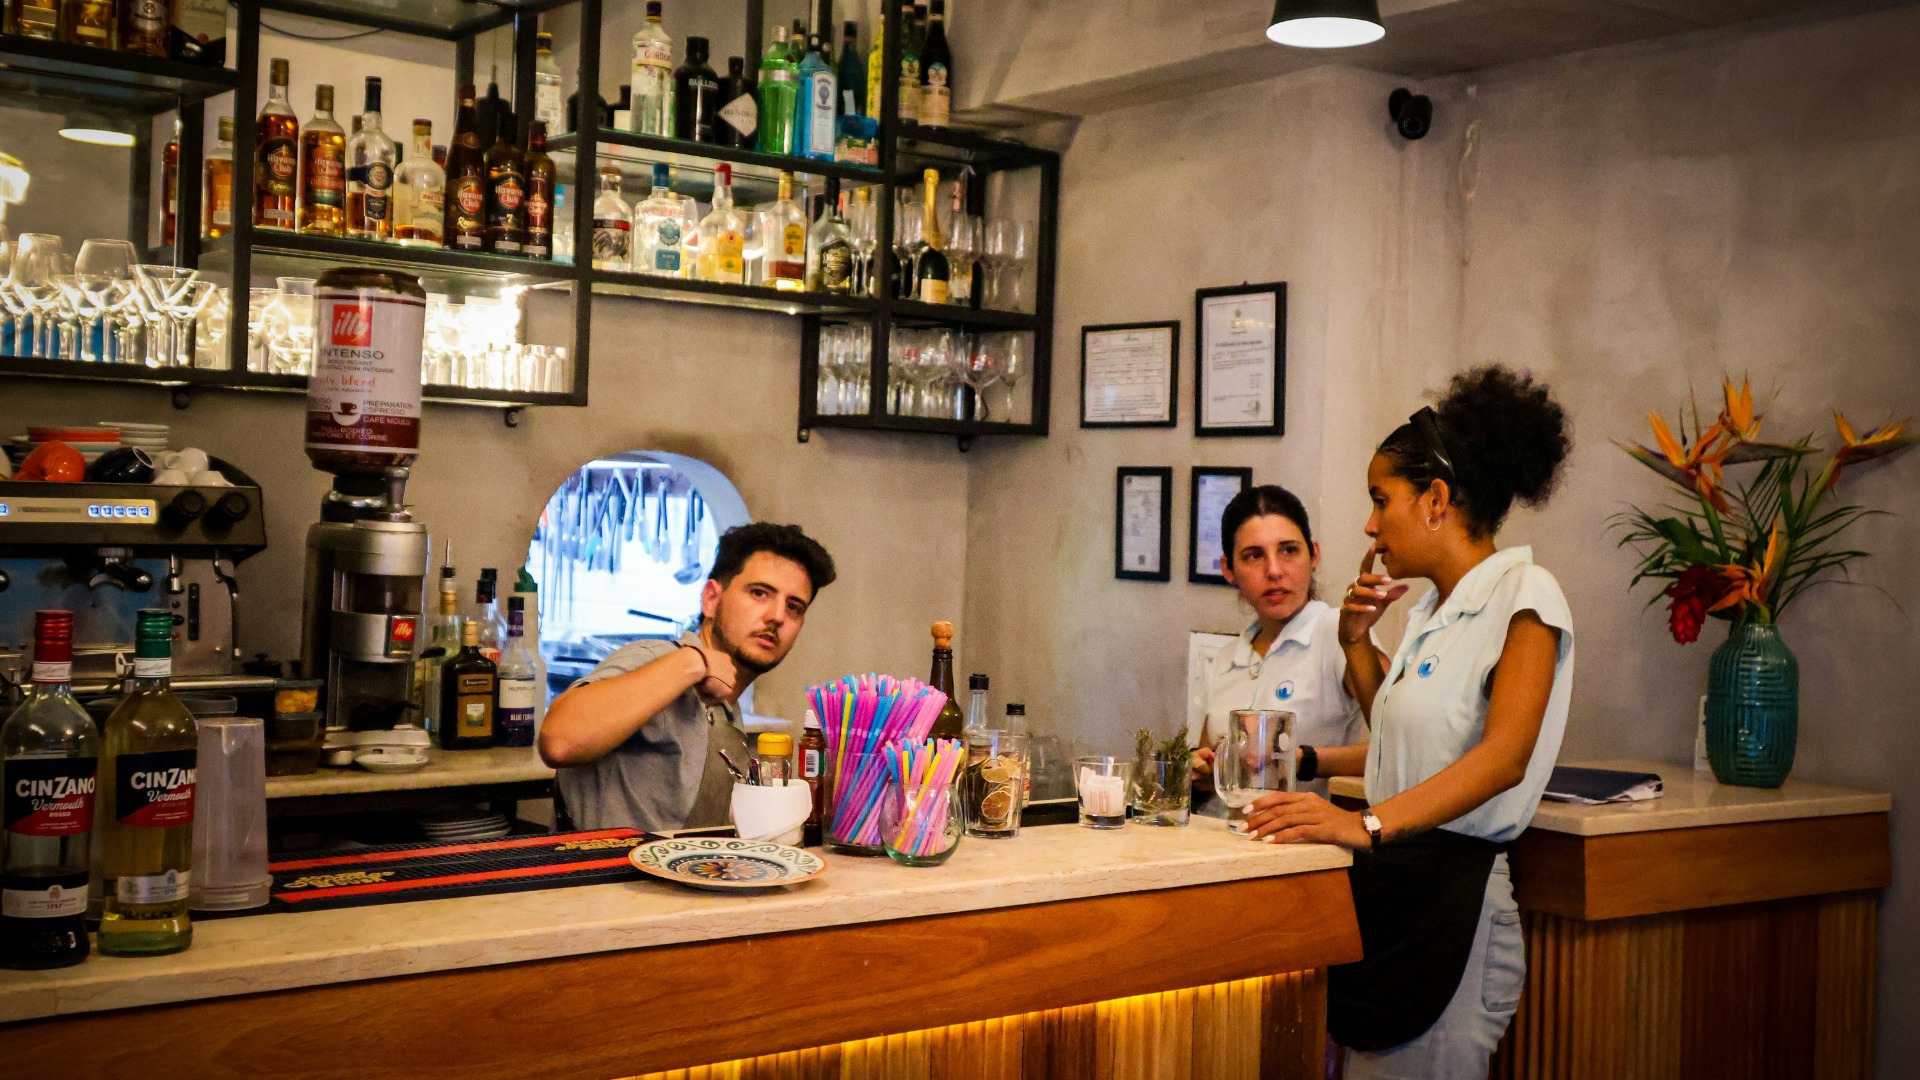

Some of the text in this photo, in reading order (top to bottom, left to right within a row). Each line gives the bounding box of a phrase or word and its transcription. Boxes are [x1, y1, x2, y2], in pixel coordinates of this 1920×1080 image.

[267, 152, 296, 167] Havana
[314, 156, 343, 169] Havana
[273, 162, 292, 174] Club
[457, 190, 483, 202] Havana
[495, 185, 523, 197] Havana
[463, 198, 480, 208] Club
[501, 194, 519, 204] Club
[506, 213, 514, 223] 7
[334, 311, 370, 342] illy
[320, 348, 385, 360] INTENSO
[341, 374, 377, 388] blend
[362, 407, 406, 415] ESPRESSO
[394, 622, 412, 638] illy
[15, 776, 96, 800] CINZANO
[31, 797, 85, 812] Vermouth
